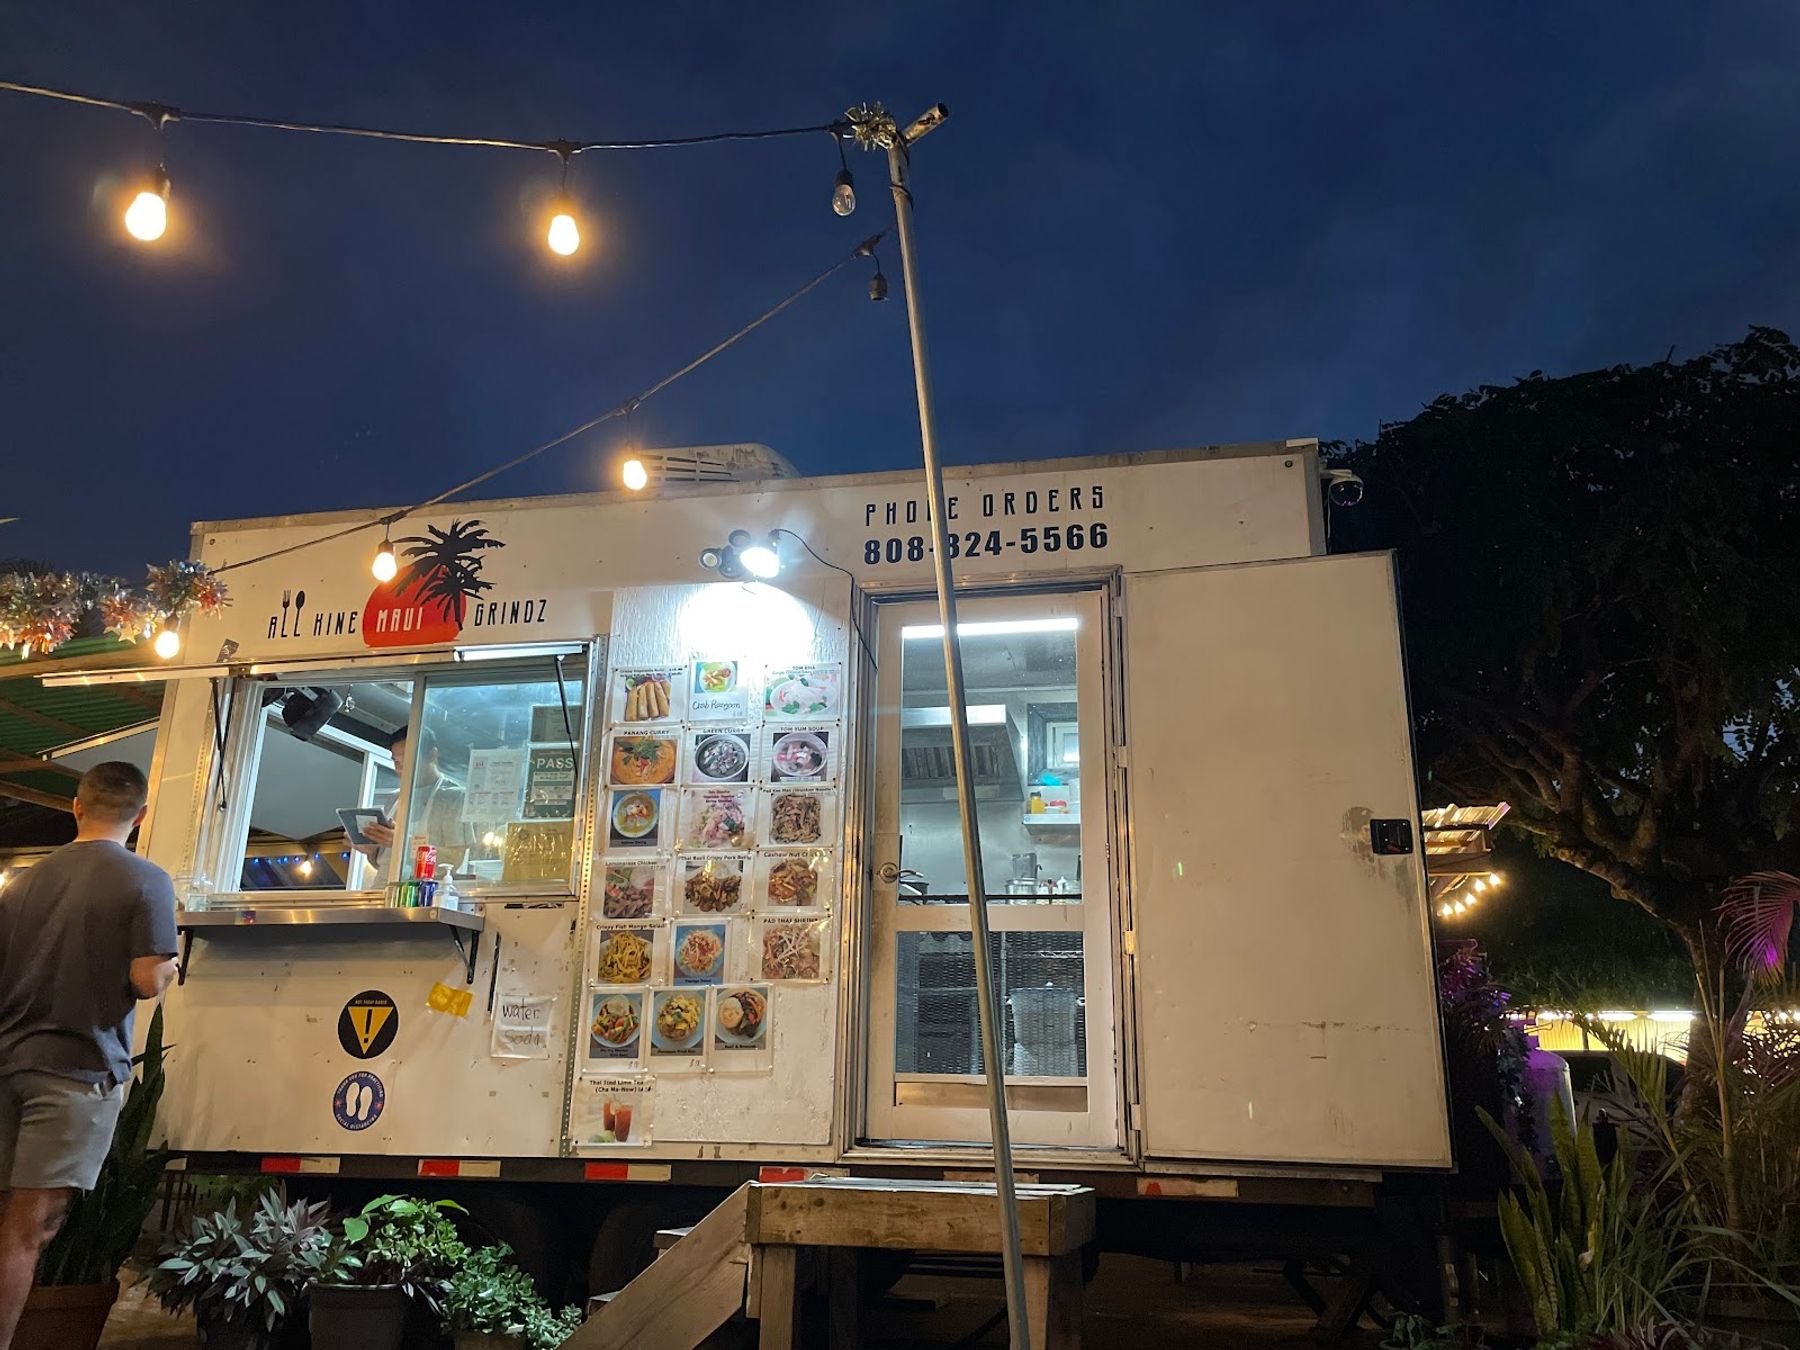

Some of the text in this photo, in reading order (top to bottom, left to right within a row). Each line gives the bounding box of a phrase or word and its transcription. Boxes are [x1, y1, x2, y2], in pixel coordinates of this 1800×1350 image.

[865, 485, 1104, 526] PHOE ORDERS
[267, 588, 548, 639] ALL KINE MAUI GRINDZ
[536, 757, 574, 769] PASS
[335, 1113, 378, 1130] SOCIAL DISTANCING
